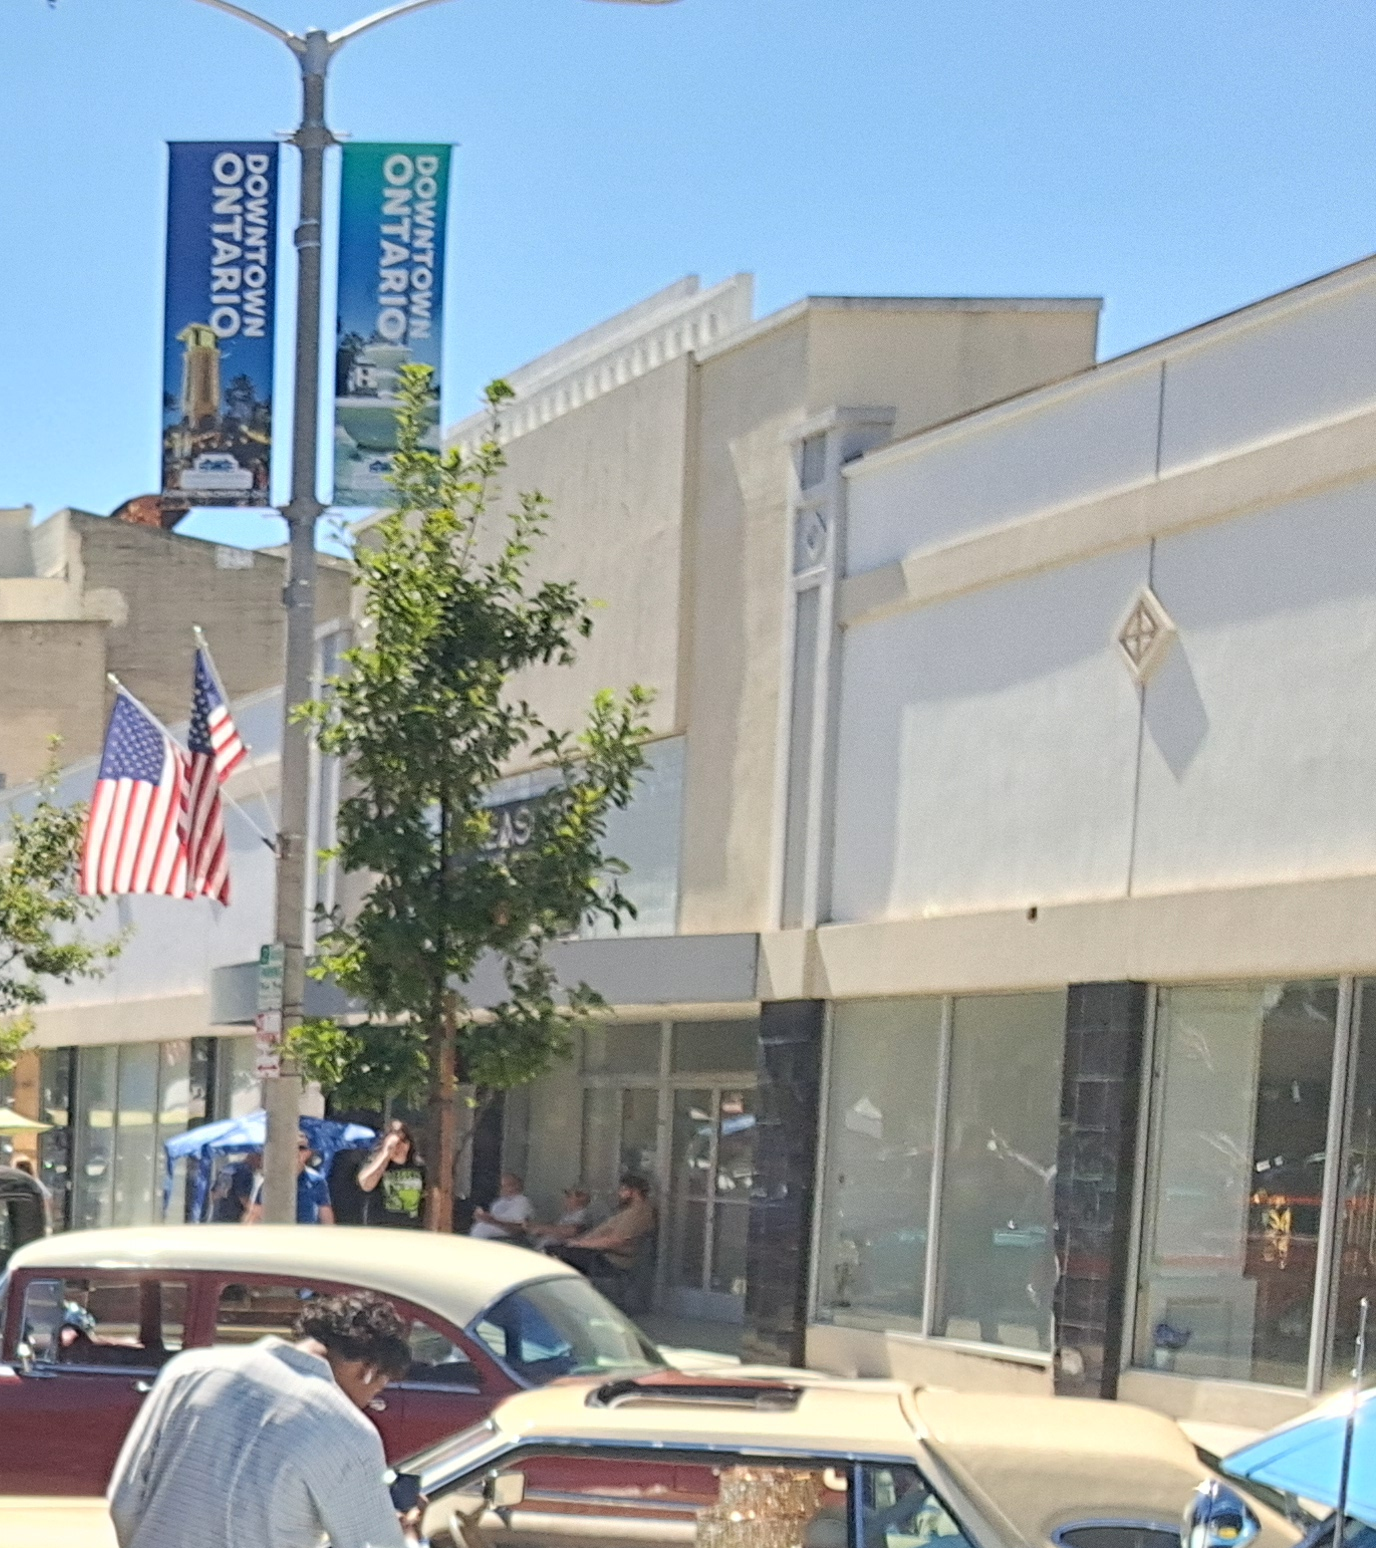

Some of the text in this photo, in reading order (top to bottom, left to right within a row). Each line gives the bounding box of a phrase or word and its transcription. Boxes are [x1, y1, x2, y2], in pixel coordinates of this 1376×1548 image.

[210, 153, 244, 338] ONTARIO
[244, 154, 269, 337] DOWNTOWN
[378, 154, 414, 339] ONTARIO
[410, 156, 438, 338] DOWNTOWN
